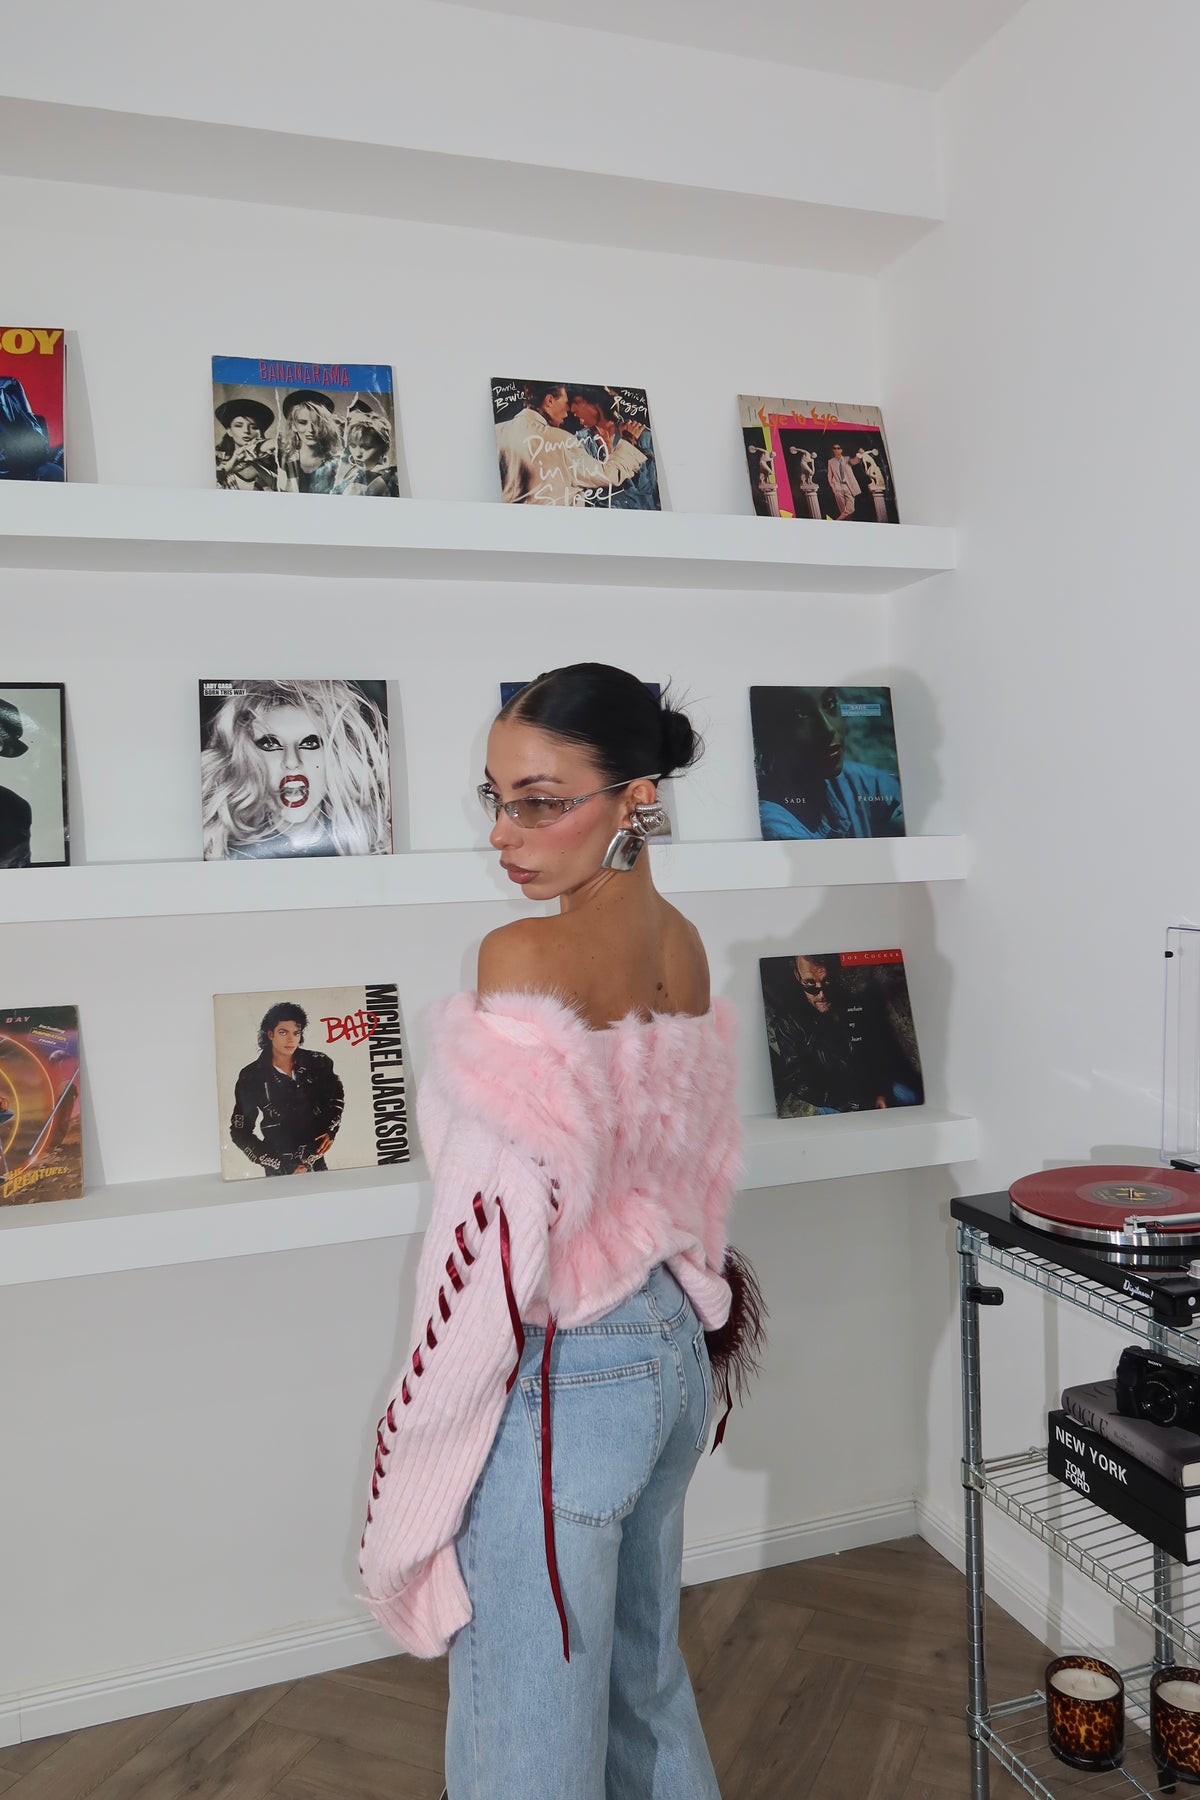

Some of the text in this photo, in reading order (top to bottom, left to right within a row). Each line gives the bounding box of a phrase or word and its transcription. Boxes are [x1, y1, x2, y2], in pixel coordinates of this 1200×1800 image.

[0, 328, 63, 355] OY
[258, 360, 350, 388] BANANARAMA
[493, 382, 517, 396] David
[620, 389, 647, 405] Mick
[494, 391, 527, 413] Bowie
[610, 396, 648, 418] Jagger
[522, 434, 610, 464] Dancing
[539, 460, 564, 481] in
[6, 1015, 30, 1024] DAY
[320, 1009, 378, 1046] BAD
[365, 984, 402, 1073] MICHAEL
[371, 1072, 410, 1166] JACKSON
[3, 1166, 68, 1198] CREATURES
[1055, 1425, 1086, 1456] NEW
[1089, 1447, 1128, 1485] YORK
[1065, 1459, 1086, 1481] TOM
[1065, 1472, 1091, 1494] FORD
